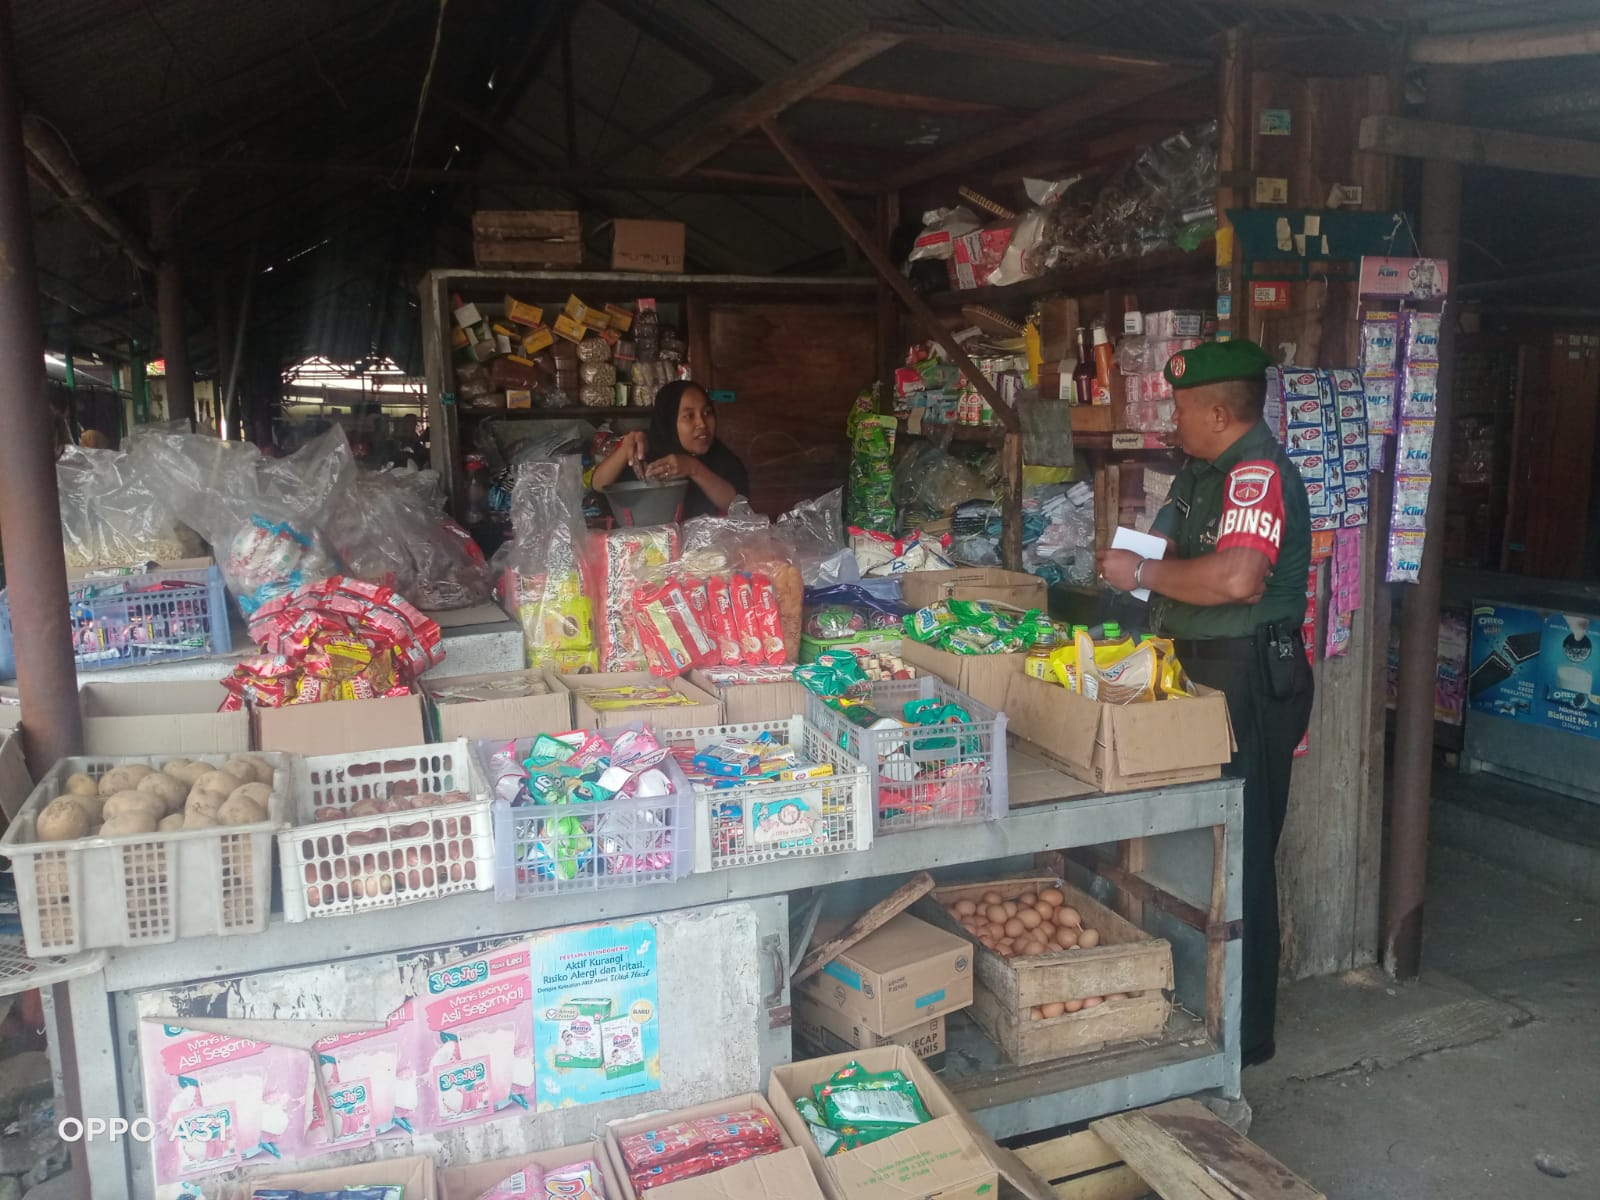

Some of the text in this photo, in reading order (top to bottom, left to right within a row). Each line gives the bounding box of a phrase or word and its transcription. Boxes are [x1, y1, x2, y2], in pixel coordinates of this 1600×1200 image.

[1415, 334, 1437, 345] Klin
[1411, 391, 1433, 403] Klin
[1406, 449, 1428, 460] Klin
[1402, 505, 1425, 517] Klin
[1396, 559, 1419, 571] Klin
[566, 954, 624, 971] Aktif Kurangi
[543, 974, 568, 985] Risiko
[570, 968, 597, 980] Alergi
[600, 966, 617, 975] dan
[449, 992, 478, 1009] Manis
[441, 1007, 462, 1026] Asli
[914, 1041, 938, 1057] ANIS
[179, 1050, 202, 1071] Asli
